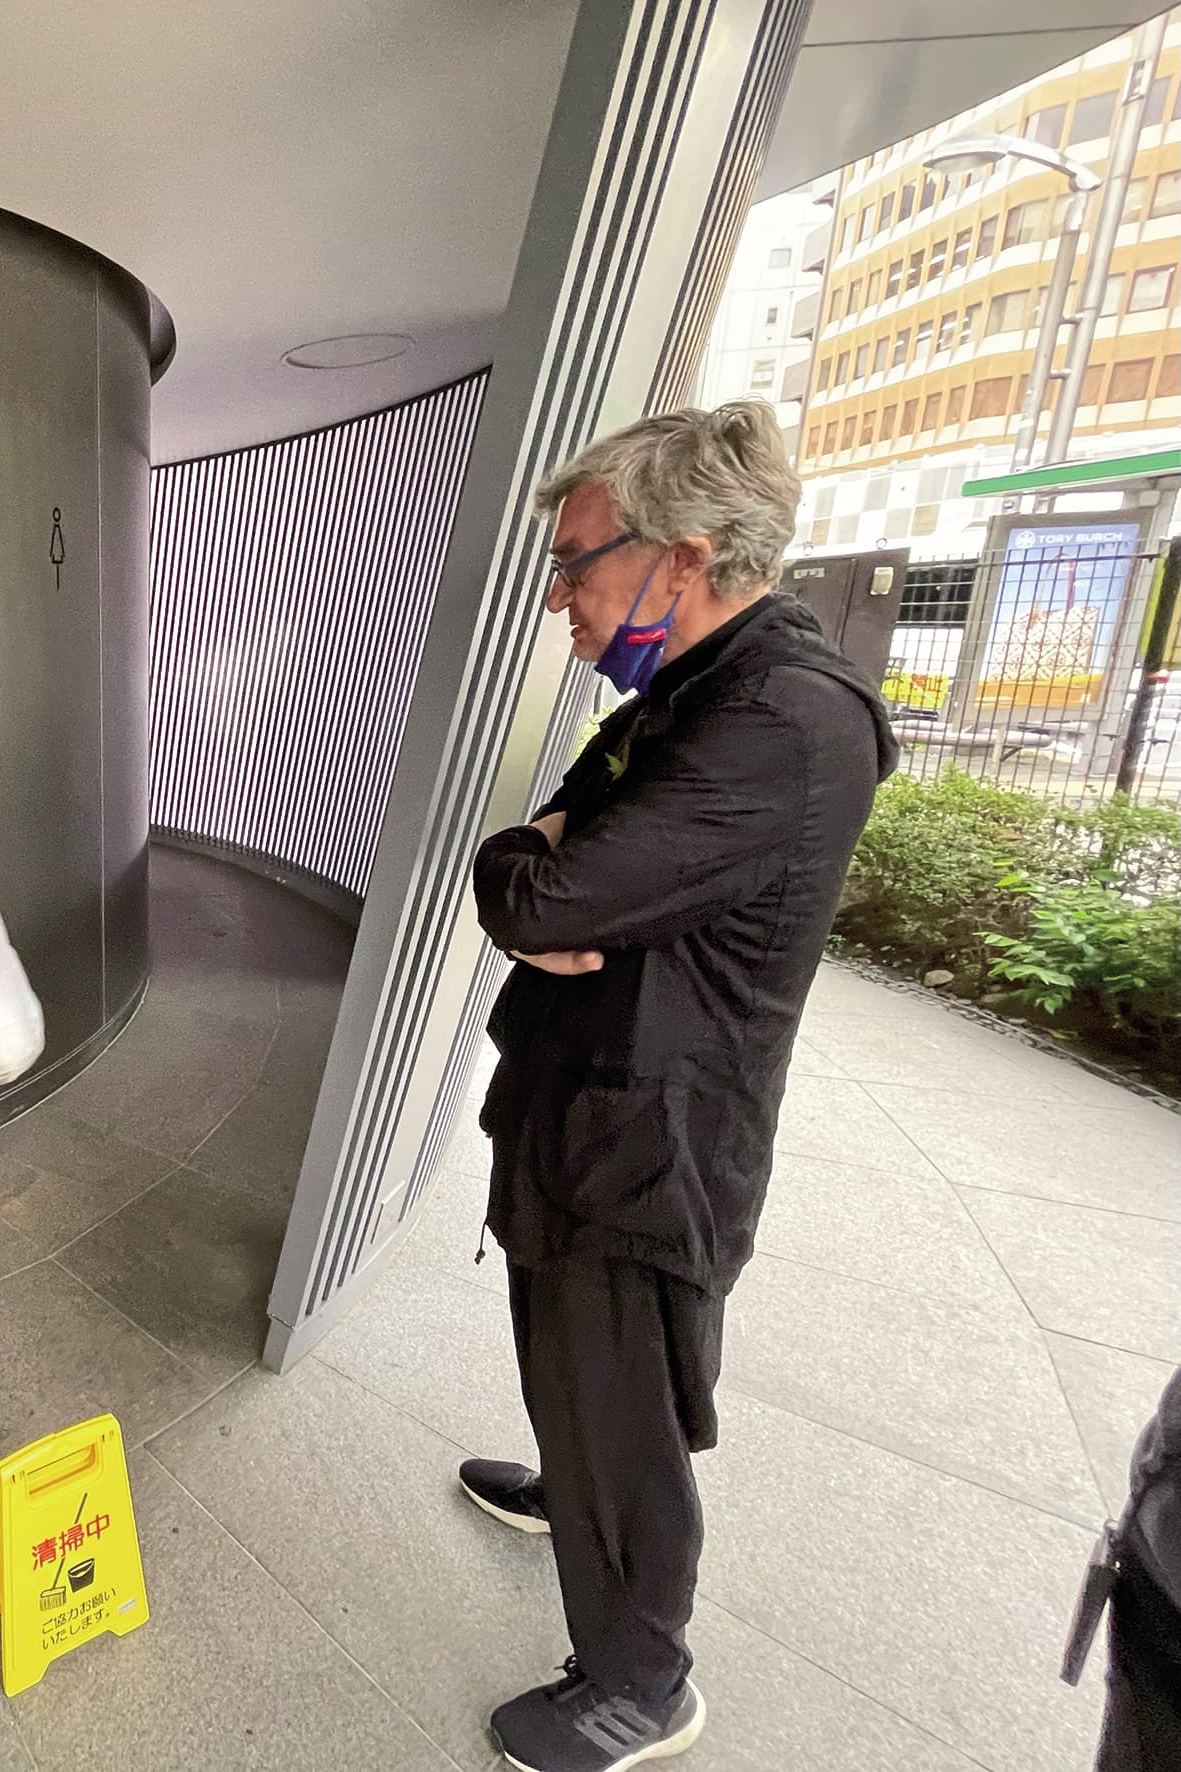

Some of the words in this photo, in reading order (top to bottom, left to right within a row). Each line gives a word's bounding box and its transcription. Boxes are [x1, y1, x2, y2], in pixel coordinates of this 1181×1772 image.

[1038, 534, 1074, 544] TORY
[1076, 532, 1123, 542] BURCH
[31, 1514, 110, 1571] 清掃中
[42, 1587, 116, 1634] ご協力お願い
[42, 1608, 110, 1650] いたします。
